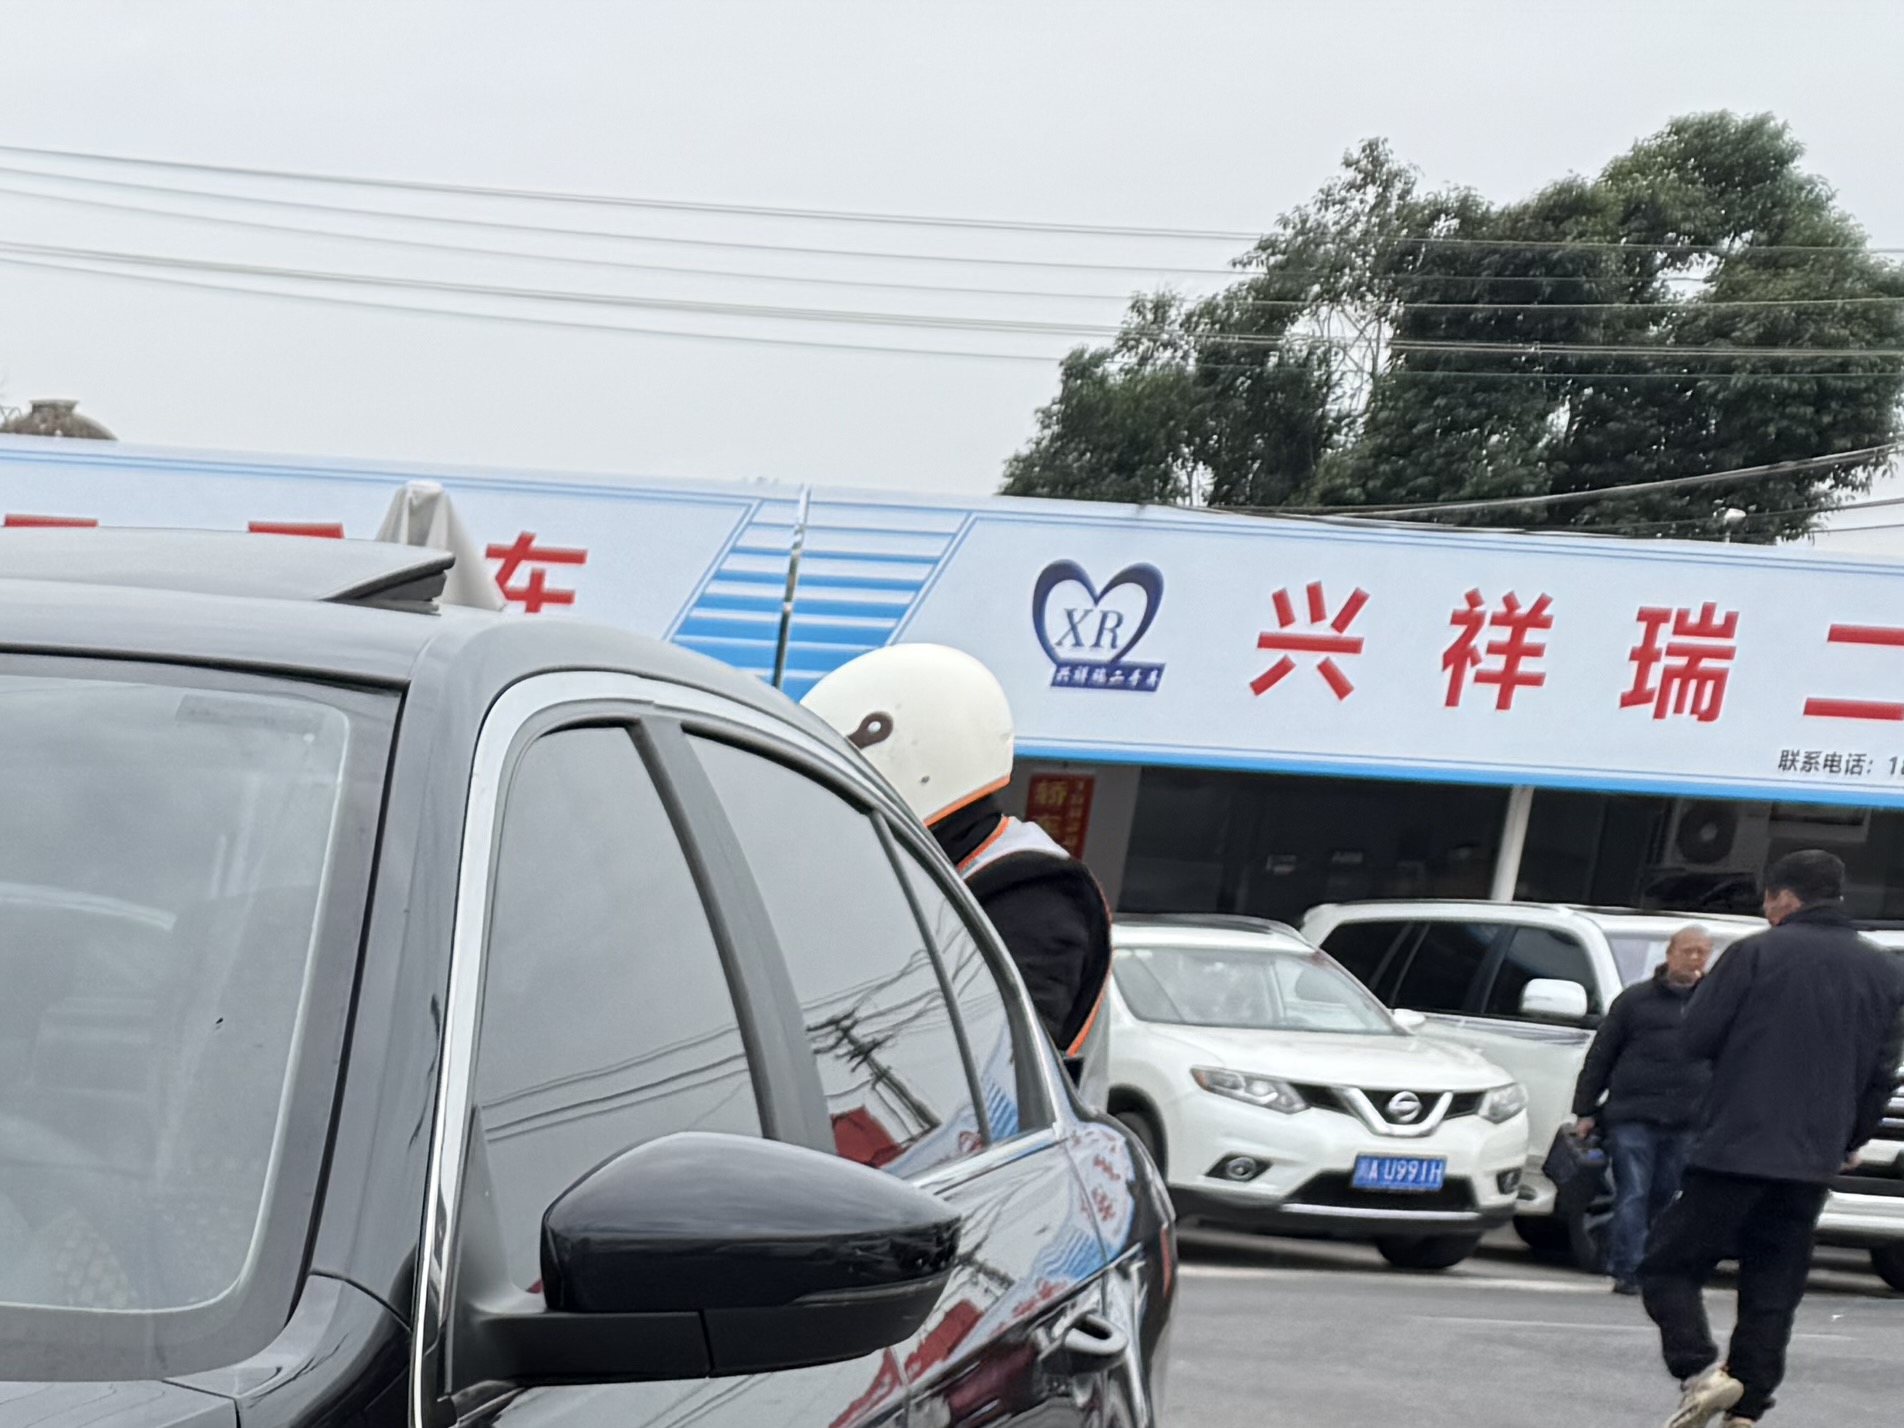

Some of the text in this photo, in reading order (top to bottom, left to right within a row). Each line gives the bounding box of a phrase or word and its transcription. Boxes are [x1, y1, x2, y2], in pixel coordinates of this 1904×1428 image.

[1055, 608, 1124, 649] XR
[1249, 579, 1904, 723] 兴祥瑞二
